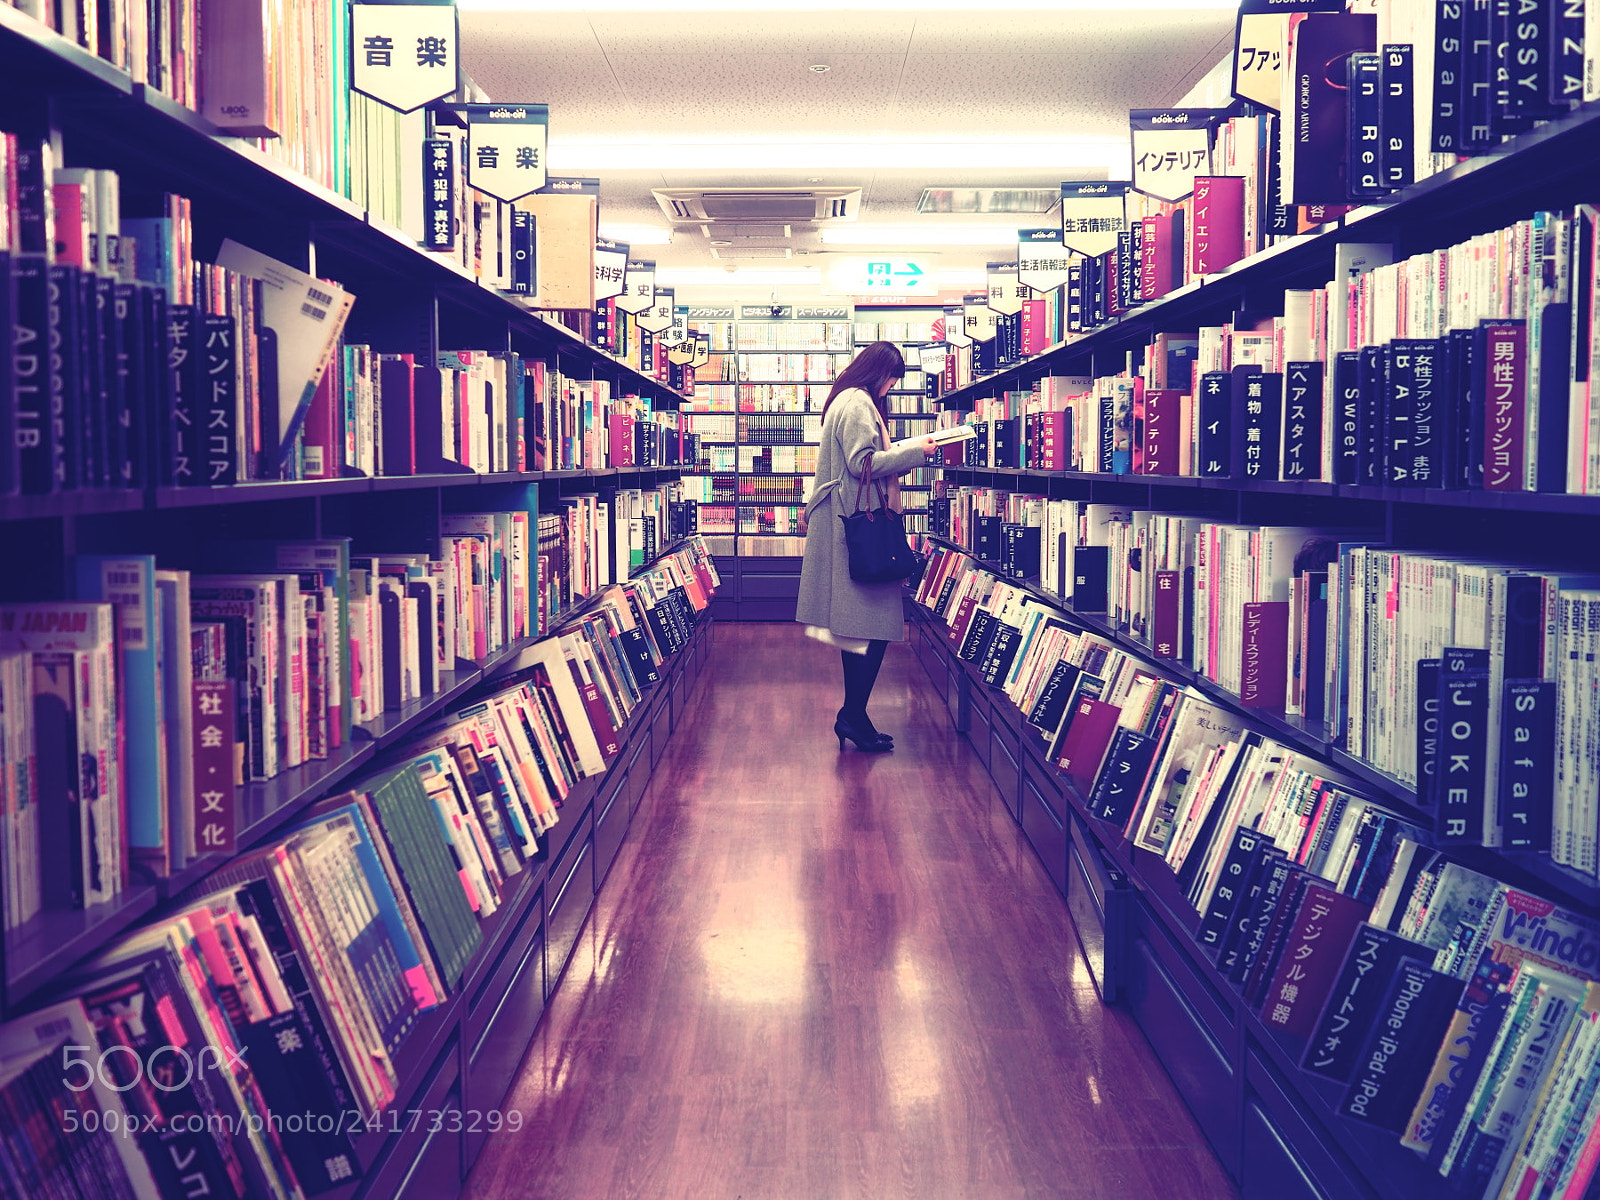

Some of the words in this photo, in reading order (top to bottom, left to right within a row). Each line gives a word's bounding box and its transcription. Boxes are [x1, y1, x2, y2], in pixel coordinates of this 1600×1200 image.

[363, 35, 447, 68] 音楽
[476, 145, 539, 169] 音楽
[1137, 149, 1206, 172] インテリア
[1362, 126, 1378, 187] Red
[1065, 217, 1123, 233] 生活情報誌
[1144, 223, 1157, 297] 園芸・ガーデニング
[1196, 186, 1210, 272] ダイエット
[991, 286, 1029, 299] 料理
[1020, 259, 1068, 272] 生活情報誌
[1023, 305, 1031, 354] 育児・子ども
[12, 324, 40, 448] ADLIB
[166, 320, 192, 476] ギター・ベース
[205, 329, 230, 480] バンドスコア
[1288, 371, 1308, 475] ヘアスタイル
[1343, 388, 1360, 457] Sweet
[1413, 354, 1434, 447] 女性ファッション
[1490, 341, 1515, 485] 男性ファッション
[622, 418, 630, 465] ビジネス
[1045, 416, 1054, 469] 生活情報誌
[1148, 396, 1160, 471] インテリア
[1207, 380, 1222, 473] ネイル
[1247, 383, 1262, 476] 着物・着付け
[22, 611, 87, 634] JAPAN
[1158, 577, 1172, 655] 住宅
[632, 632, 657, 681] 生け花
[1245, 611, 1262, 701] レディースファッション
[587, 689, 618, 754] 歴史
[199, 692, 226, 847] 社会・文化
[1103, 739, 1141, 818] ブランド
[1446, 690, 1472, 837] JOKER
[1512, 695, 1536, 845] Safari
[1203, 836, 1257, 943] Begin
[1271, 903, 1331, 1026] デジタル機器
[1313, 939, 1380, 1068] スマートフォン
